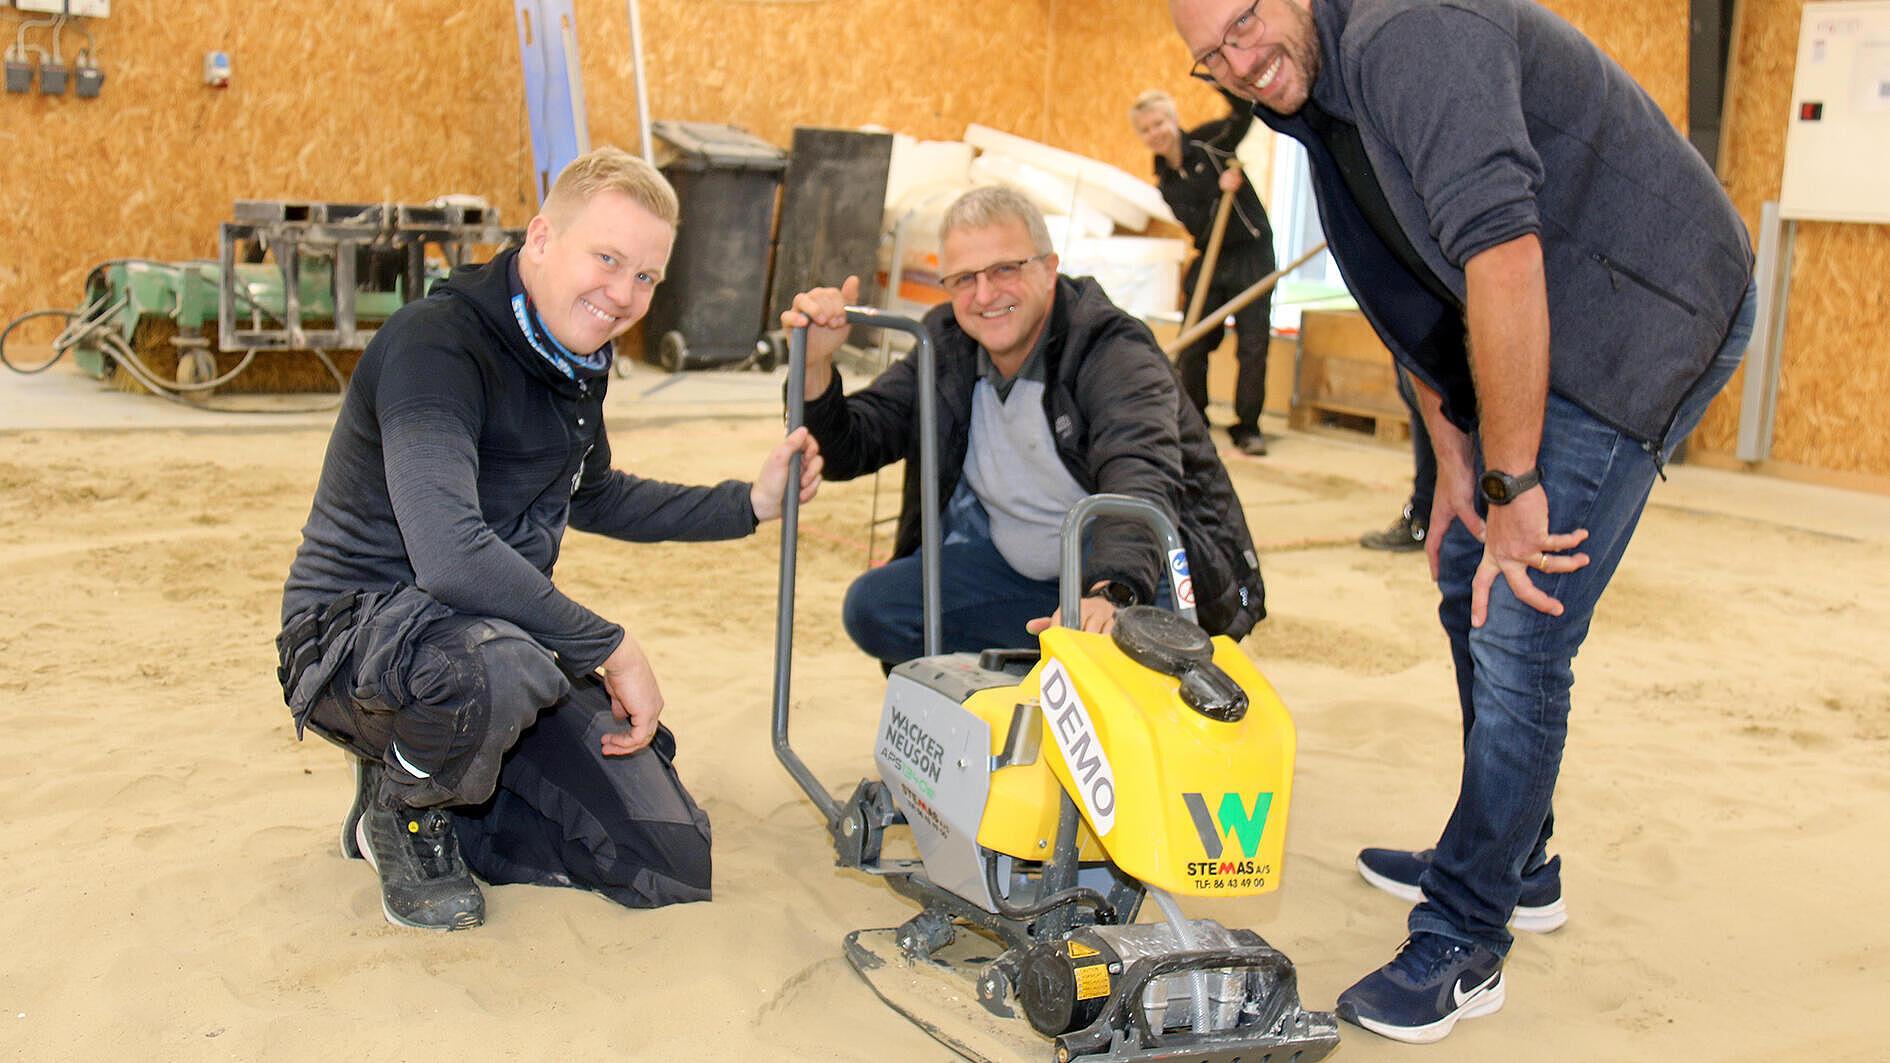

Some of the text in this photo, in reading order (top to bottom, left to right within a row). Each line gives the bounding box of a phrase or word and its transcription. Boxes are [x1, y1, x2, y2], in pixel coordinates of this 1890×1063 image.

[885, 724, 941, 783] NEUSON
[892, 705, 944, 767] WACKER
[1042, 669, 1115, 817] DEMO
[1187, 861, 1271, 876] STEMAS A/S
[1214, 879, 1224, 889] 86
[1227, 879, 1238, 889] 43
[1241, 878, 1252, 888] 49
[1254, 877, 1265, 888] 00
